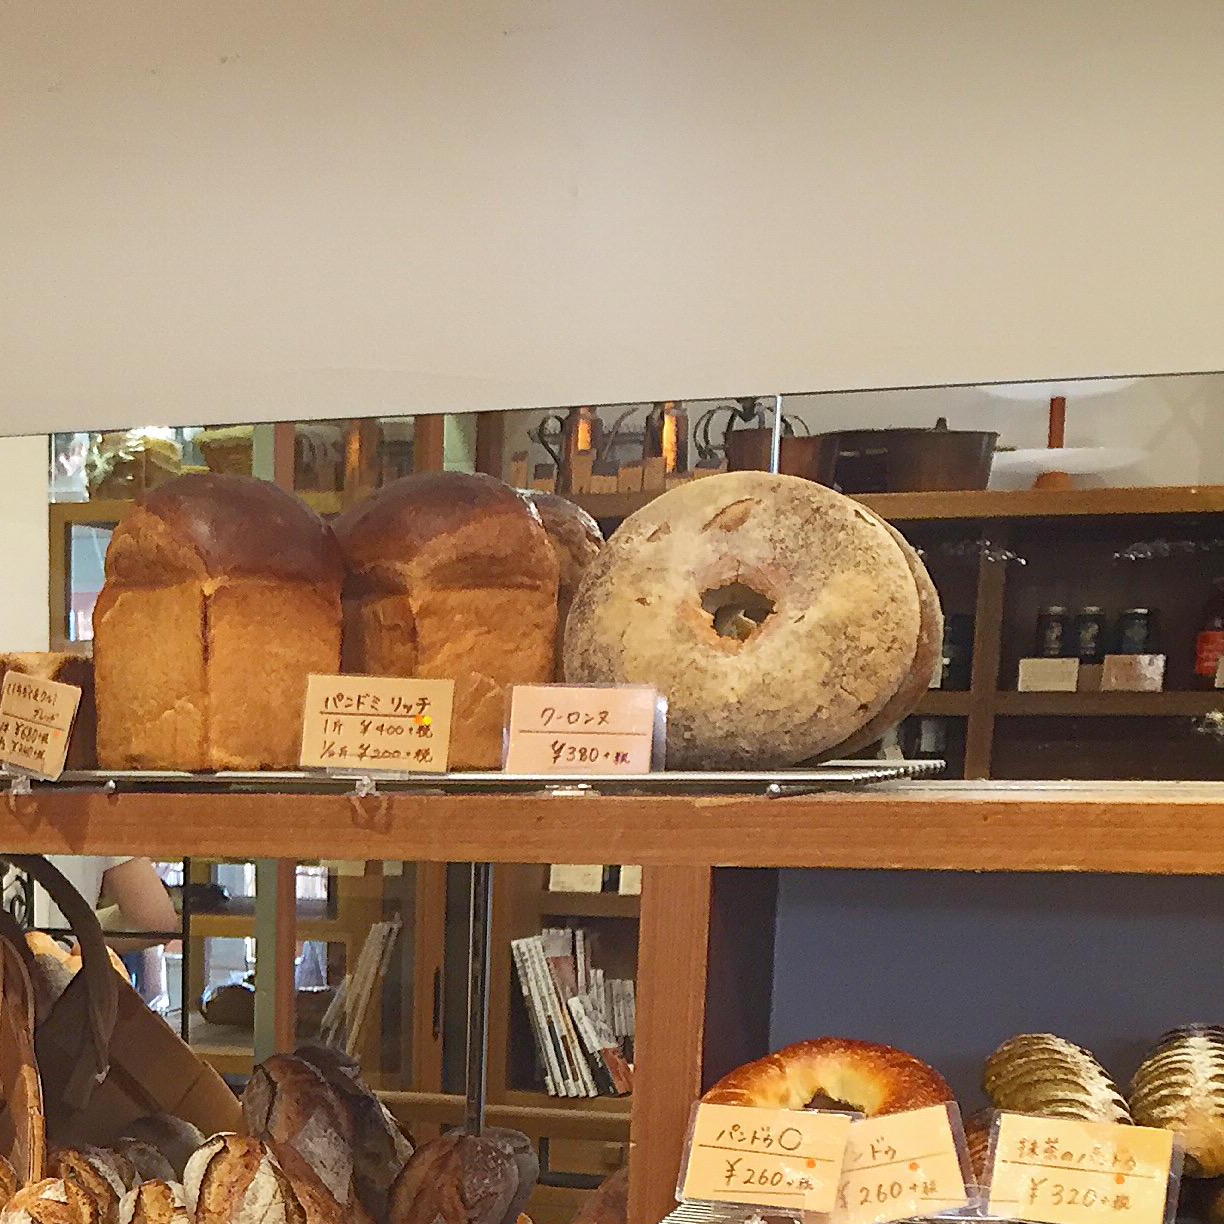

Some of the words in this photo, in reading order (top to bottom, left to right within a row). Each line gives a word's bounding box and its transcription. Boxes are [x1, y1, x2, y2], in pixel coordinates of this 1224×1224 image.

[541, 707, 609, 726] クーロンヌ
[551, 740, 630, 764] ¥380+税
